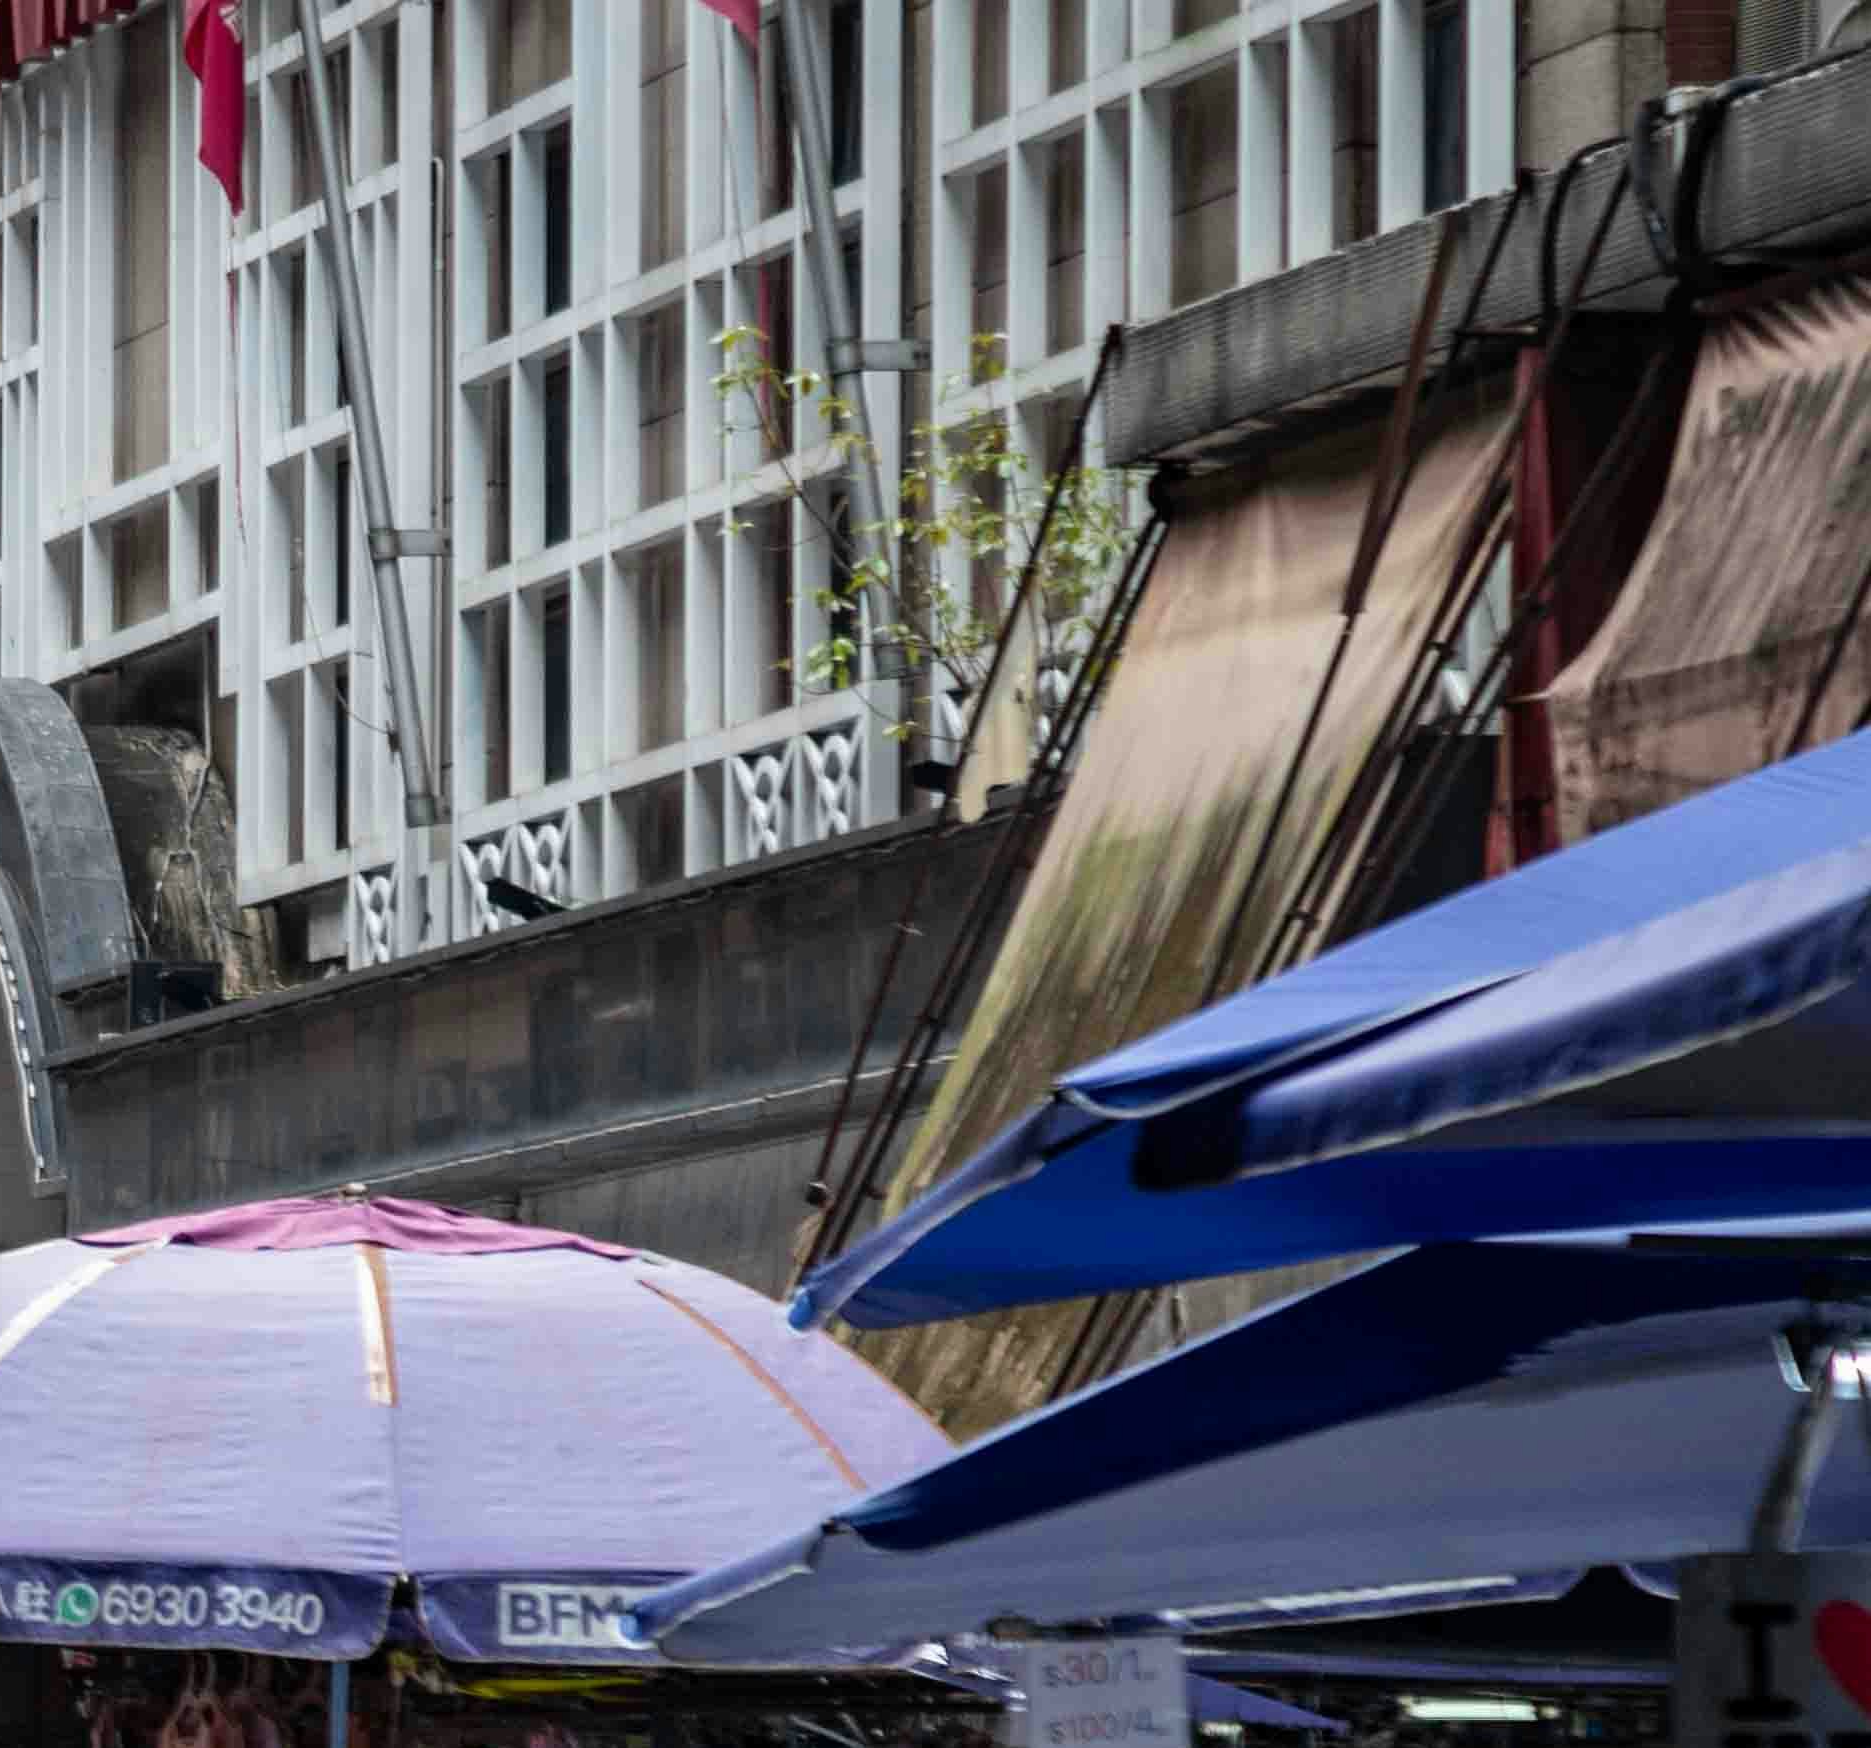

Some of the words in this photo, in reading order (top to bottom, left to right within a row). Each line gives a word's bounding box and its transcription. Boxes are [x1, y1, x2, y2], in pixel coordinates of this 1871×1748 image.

[102, 1583, 208, 1628] 6930
[213, 1585, 324, 1636] 3940
[1725, 1600, 1801, 1722] I
